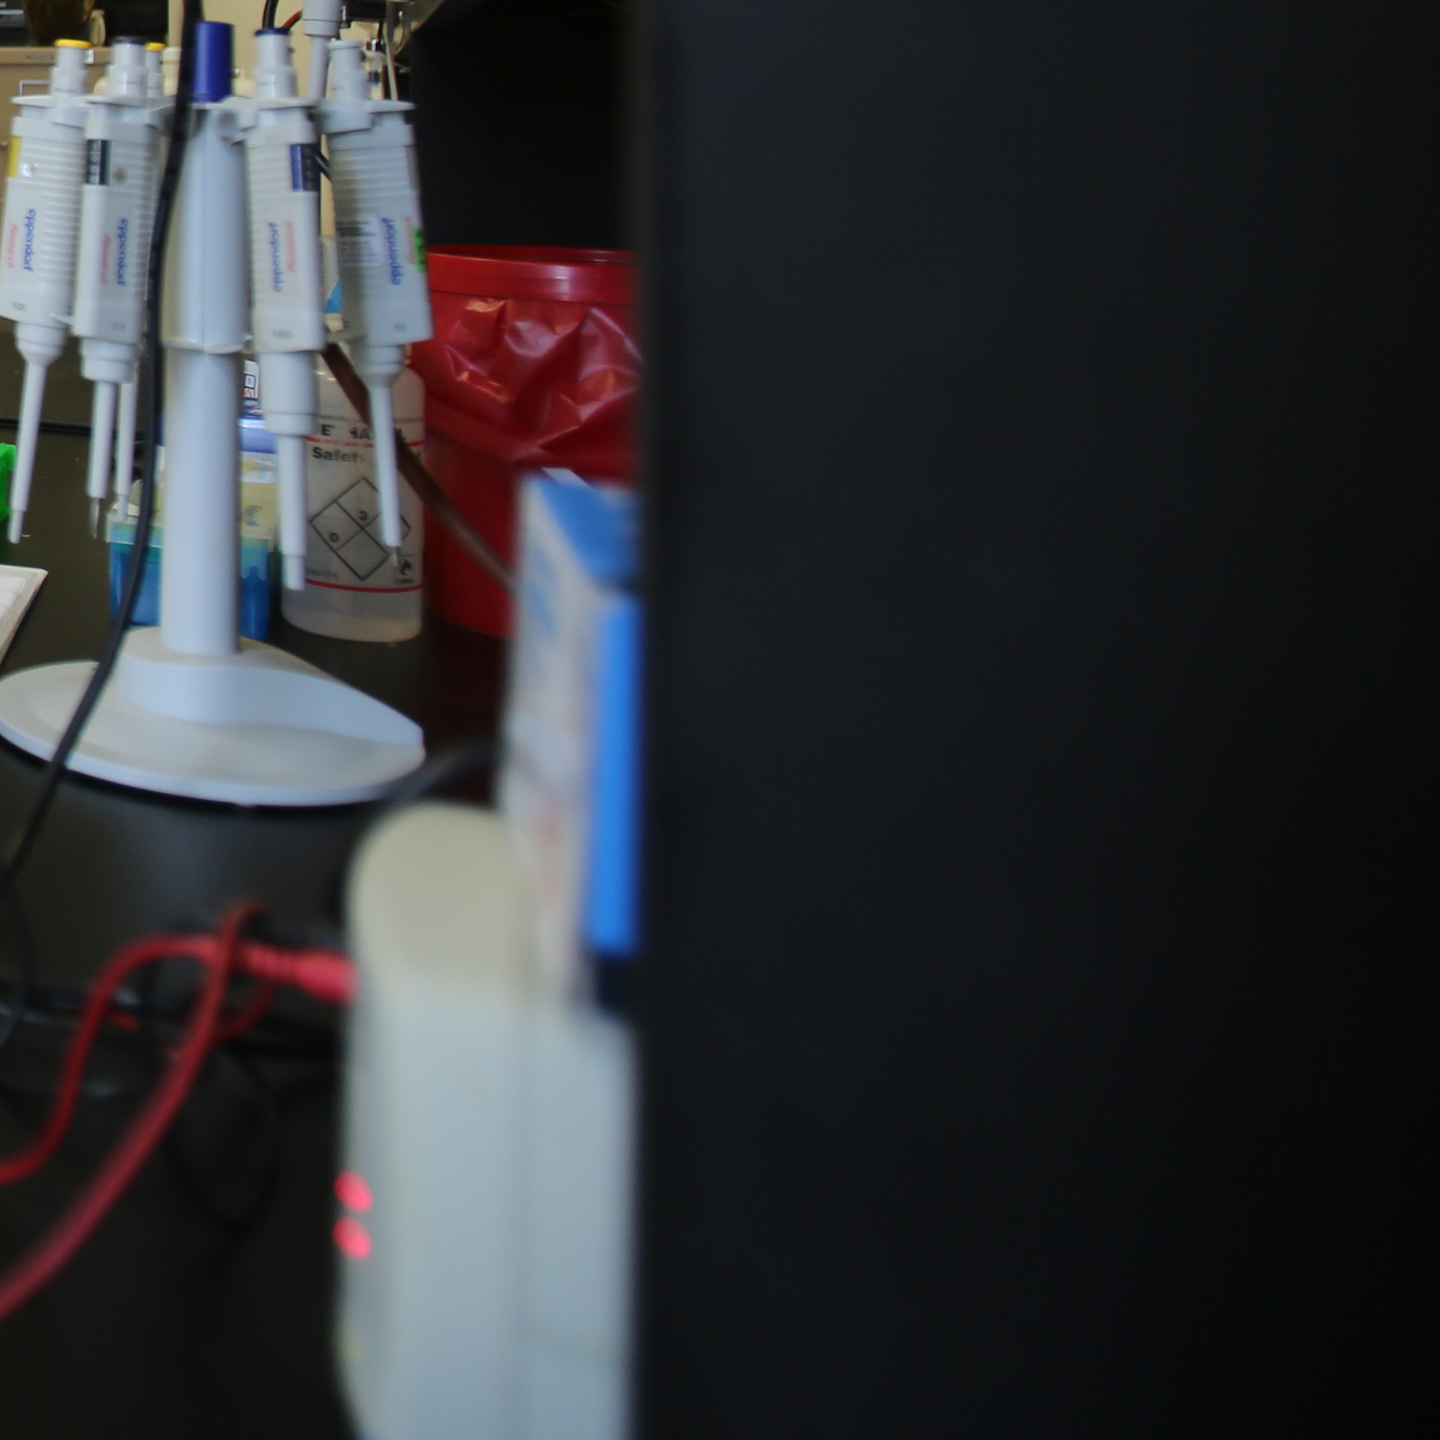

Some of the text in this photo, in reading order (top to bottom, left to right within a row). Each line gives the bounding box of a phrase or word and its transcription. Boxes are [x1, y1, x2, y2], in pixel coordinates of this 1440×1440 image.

[23, 209, 36, 272] eppendorf
[116, 218, 129, 287] eppendorf
[268, 221, 285, 293] eppendorf
[382, 217, 405, 287] eppendorf
[312, 446, 364, 462] Safet
[357, 511, 368, 521] 3
